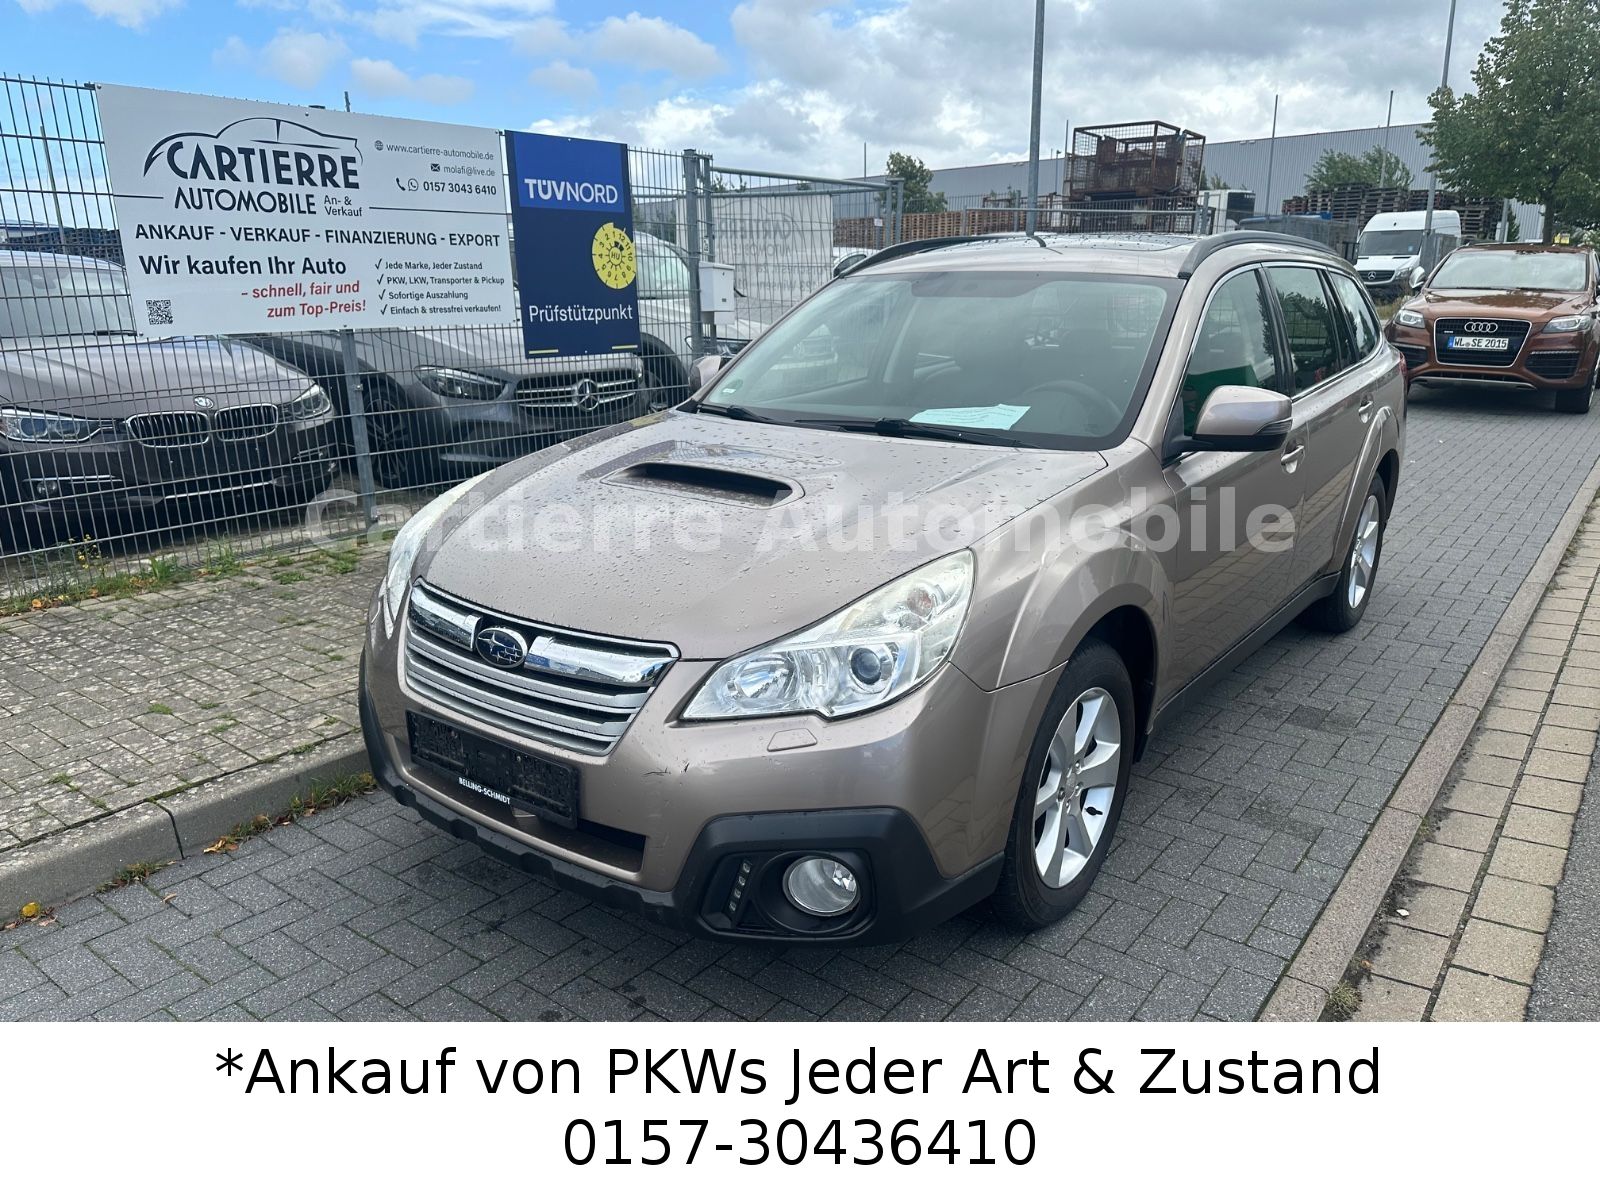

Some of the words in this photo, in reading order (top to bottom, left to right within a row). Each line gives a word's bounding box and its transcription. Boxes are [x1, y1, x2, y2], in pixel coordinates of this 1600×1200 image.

[386, 142, 494, 161] www.cartierre-automobile.de
[167, 141, 360, 189] CARTIERRE
[443, 164, 495, 177] molafi@live.de
[423, 181, 446, 193] 0157
[448, 183, 473, 194] 3043
[475, 184, 497, 196] 6410
[174, 186, 316, 215] AUTOMOBILE
[323, 195, 342, 206] An-
[343, 196, 352, 206] &
[324, 206, 363, 218] Verkauf
[135, 223, 214, 241] ANKAUF
[230, 226, 311, 243] VERKAUF
[325, 229, 437, 246] FINANZIERUNG
[449, 233, 500, 247] EXPORT
[610, 250, 620, 260] HU
[139, 255, 180, 275] Wir
[187, 254, 262, 275] kaufen
[267, 256, 295, 275] Ihr
[301, 257, 347, 275] Auto
[385, 260, 403, 270] Jede
[404, 260, 431, 272] Marke,
[432, 260, 452, 271] Jeder
[453, 260, 483, 270] Zustand
[387, 275, 408, 286] PKW,
[409, 276, 429, 286] LKW,
[430, 275, 472, 287] Transporter
[473, 276, 480, 285] &
[481, 275, 505, 286] Pickup
[252, 283, 307, 299] schnell,
[310, 281, 332, 296] fair
[336, 280, 360, 294] und
[388, 290, 424, 302] Sofortige
[426, 290, 469, 301] Auszahlung
[267, 305, 296, 318] zum
[299, 300, 367, 318] Top-Preis!
[390, 304, 419, 316] Einfach
[421, 305, 427, 314] &
[428, 304, 463, 315] stressfrei
[464, 303, 501, 314] verkaufen!
[529, 304, 633, 324] Prüfstützpunkt
[1454, 337, 1464, 347] WL
[1471, 338, 1483, 347] SE
[1484, 338, 1507, 348] 2015
[458, 776, 511, 805] BELLING-SCHMIDT
